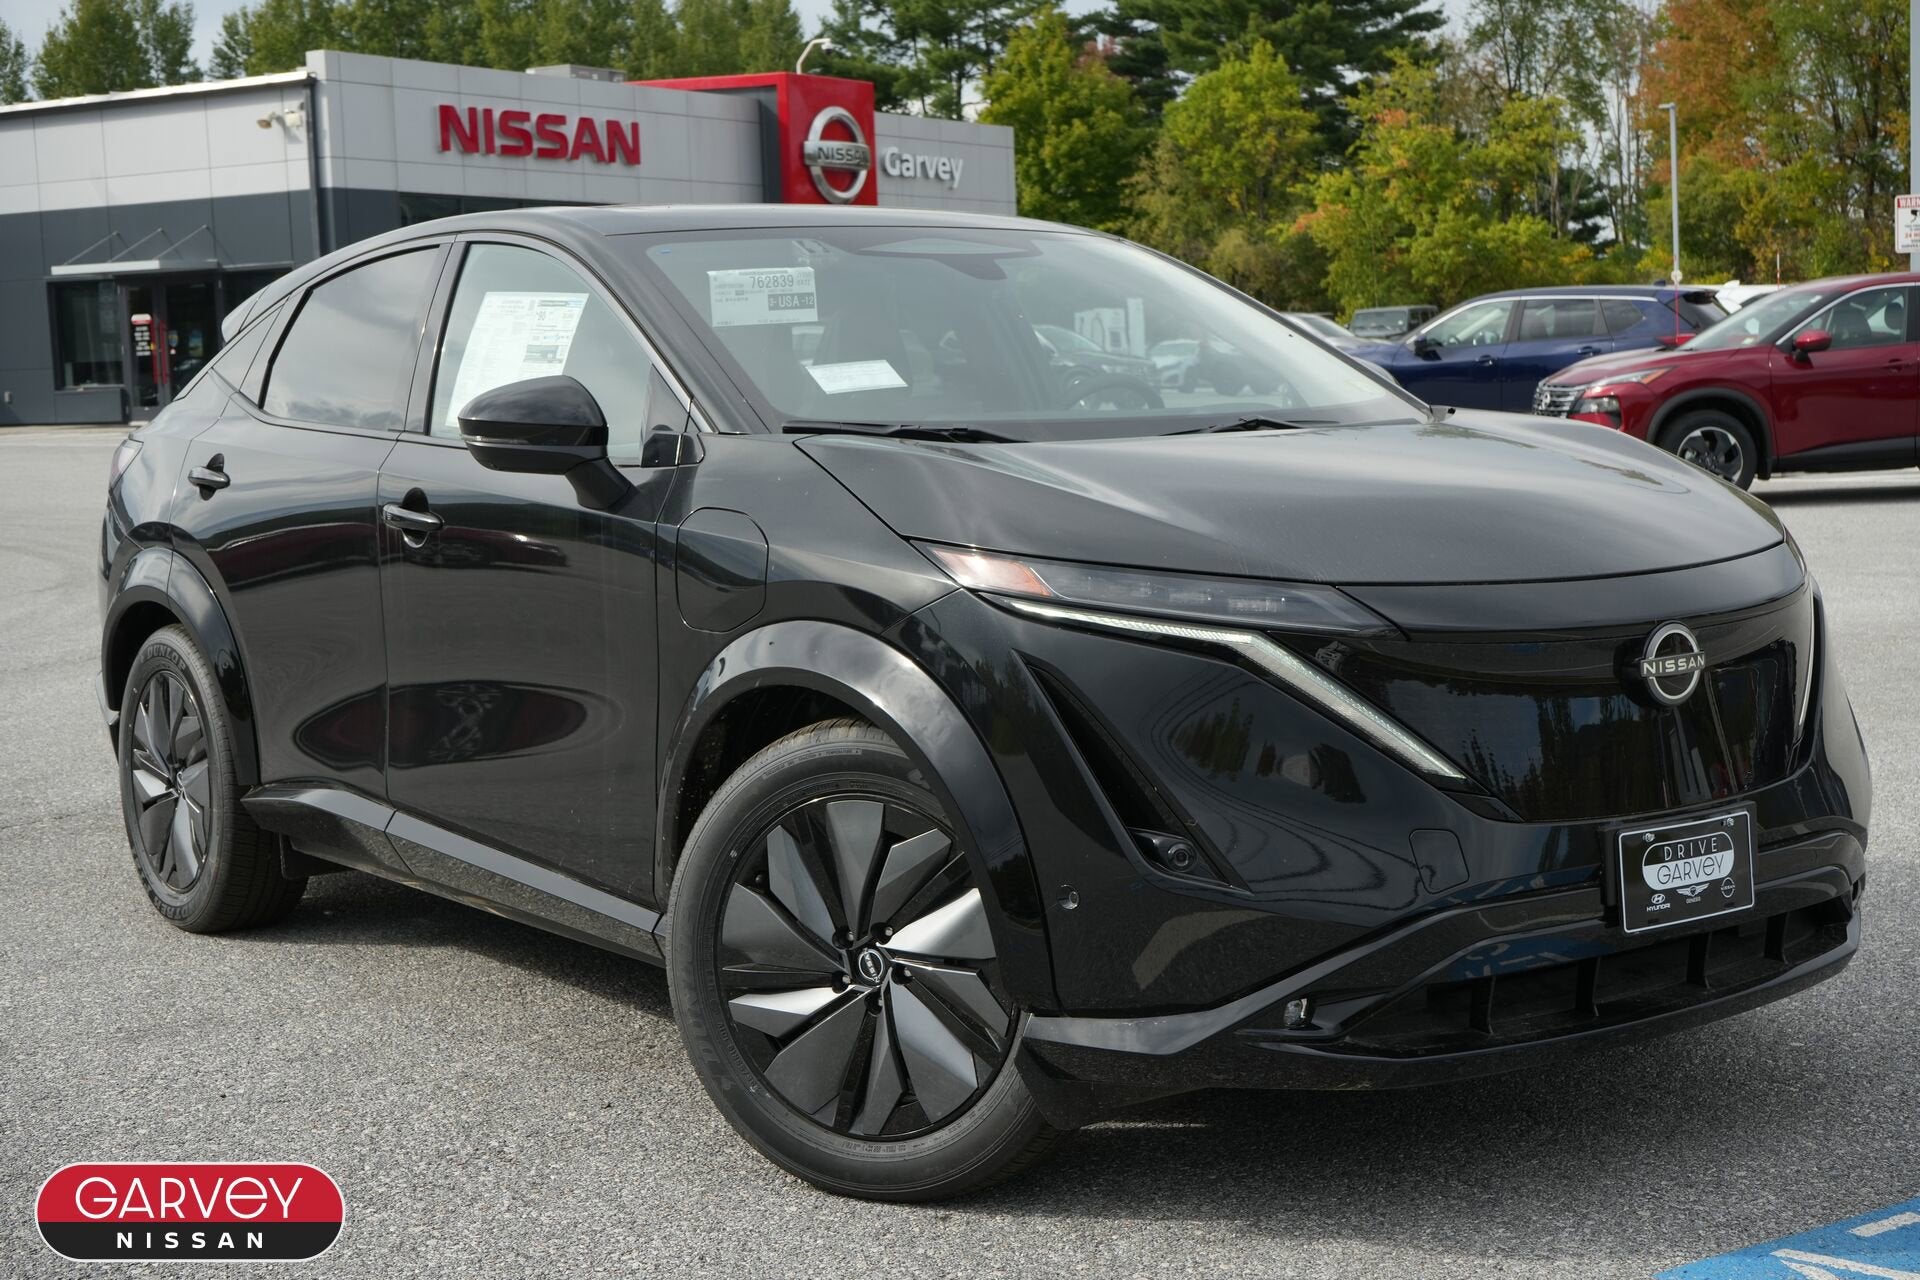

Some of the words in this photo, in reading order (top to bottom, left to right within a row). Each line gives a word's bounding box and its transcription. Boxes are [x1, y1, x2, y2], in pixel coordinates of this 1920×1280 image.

[438, 104, 641, 165] NISSAN
[884, 147, 964, 189] Garvey
[748, 274, 794, 289] 762839
[778, 295, 800, 308] USA
[1643, 654, 1705, 675] NISSAN
[1663, 837, 1718, 861] DRIVE
[1646, 902, 1671, 912] HYUNDAI
